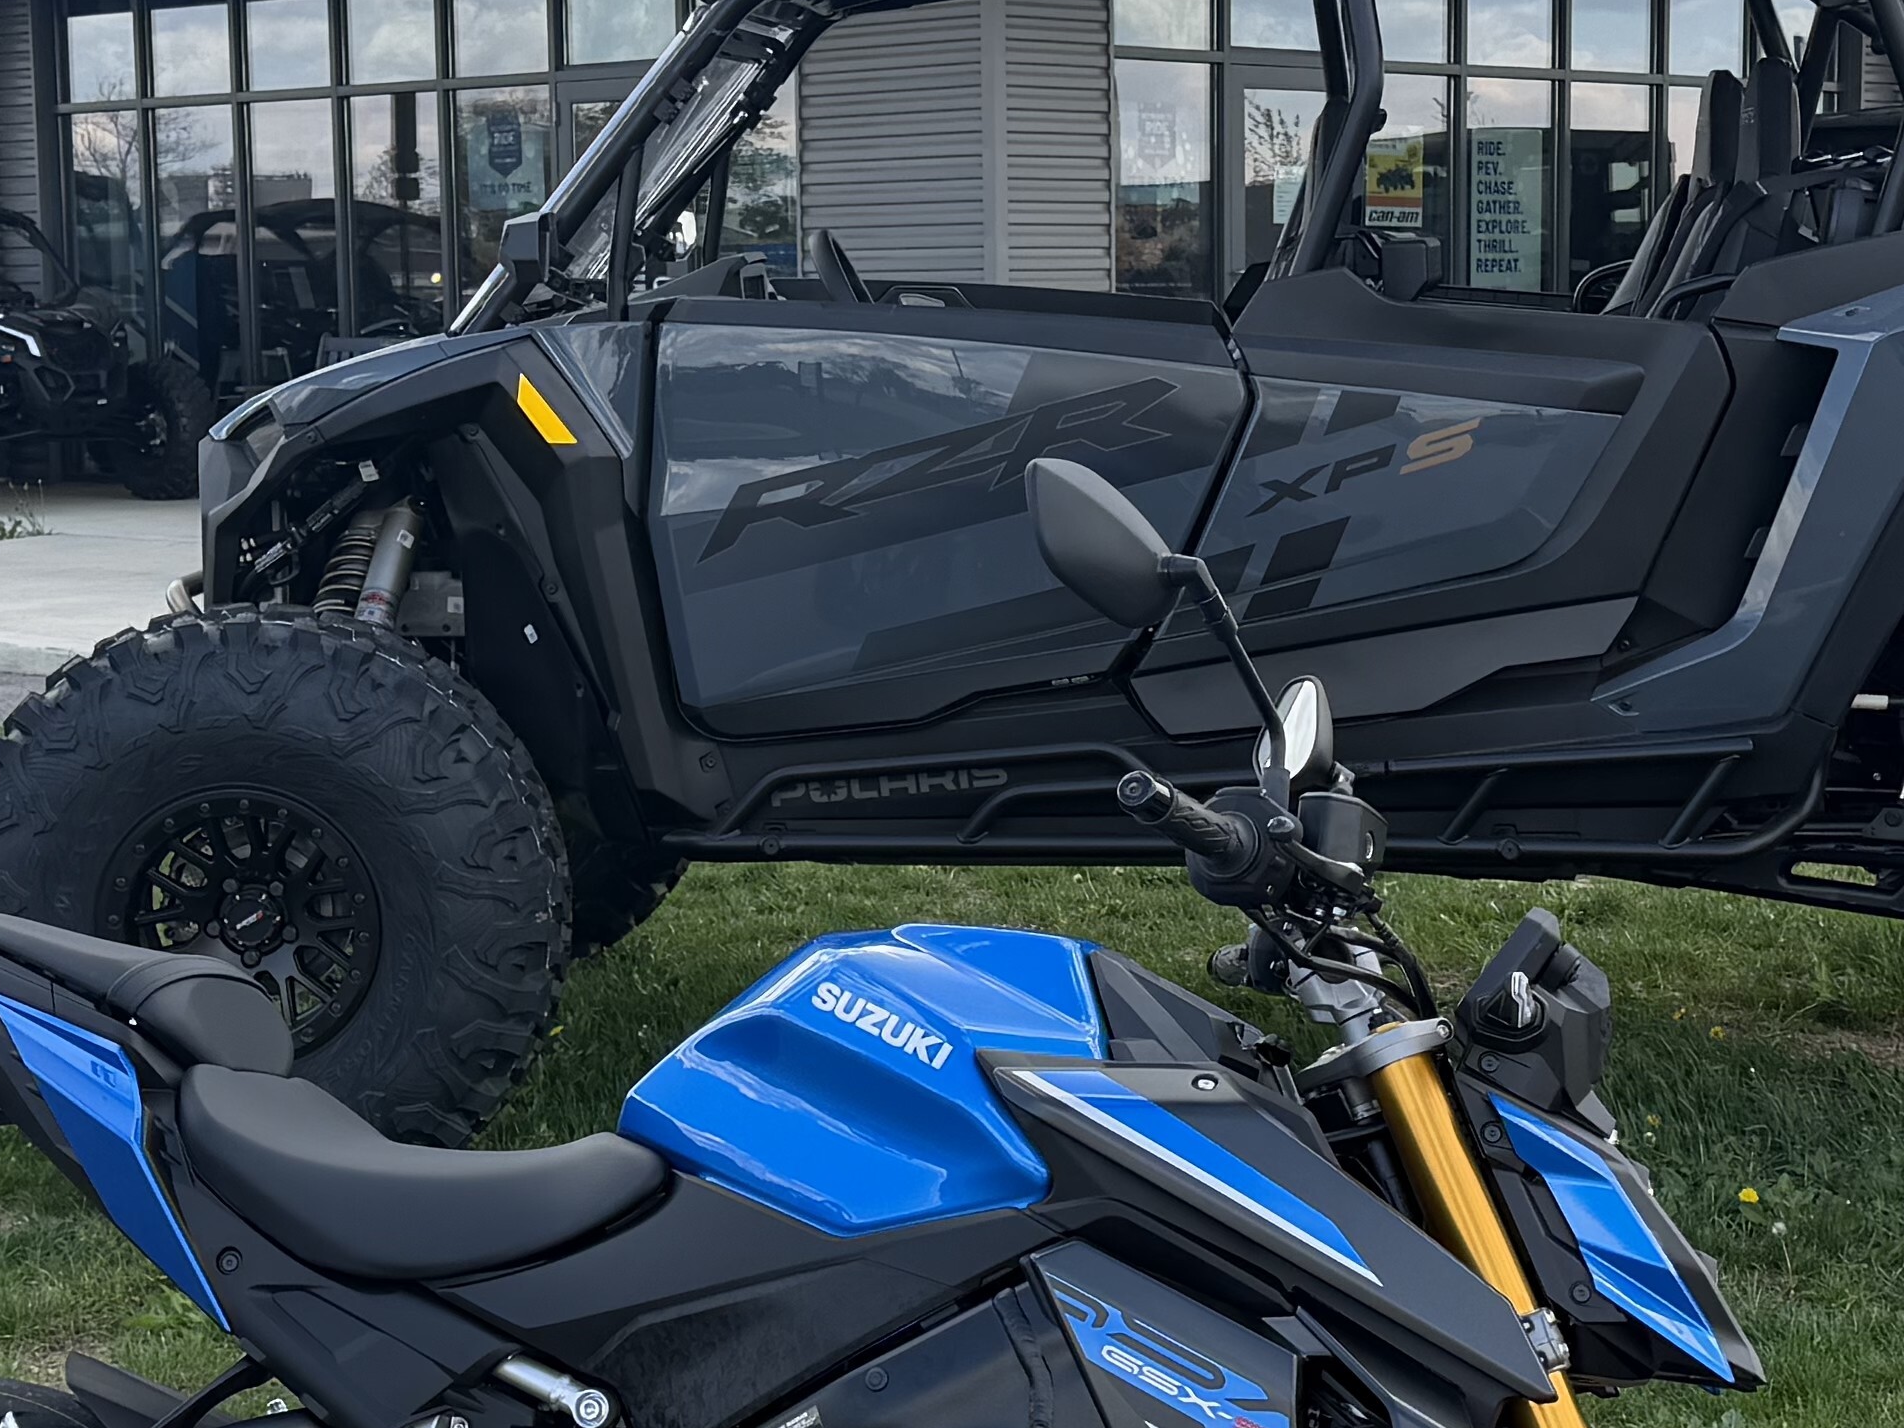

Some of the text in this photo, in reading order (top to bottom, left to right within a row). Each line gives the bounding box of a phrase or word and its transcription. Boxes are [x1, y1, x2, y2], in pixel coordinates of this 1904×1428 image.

[1477, 141, 1506, 156] RIDE.
[1477, 160, 1502, 176] REV.
[1476, 180, 1517, 195] CHASE.
[1476, 200, 1523, 214] GATHER.
[1477, 219, 1530, 234] EXPLORE.
[1476, 239, 1519, 253] THRILL.
[1476, 258, 1521, 273] REPEAT.
[697, 376, 1181, 564] RZR
[811, 981, 954, 1070] SUZUKI
